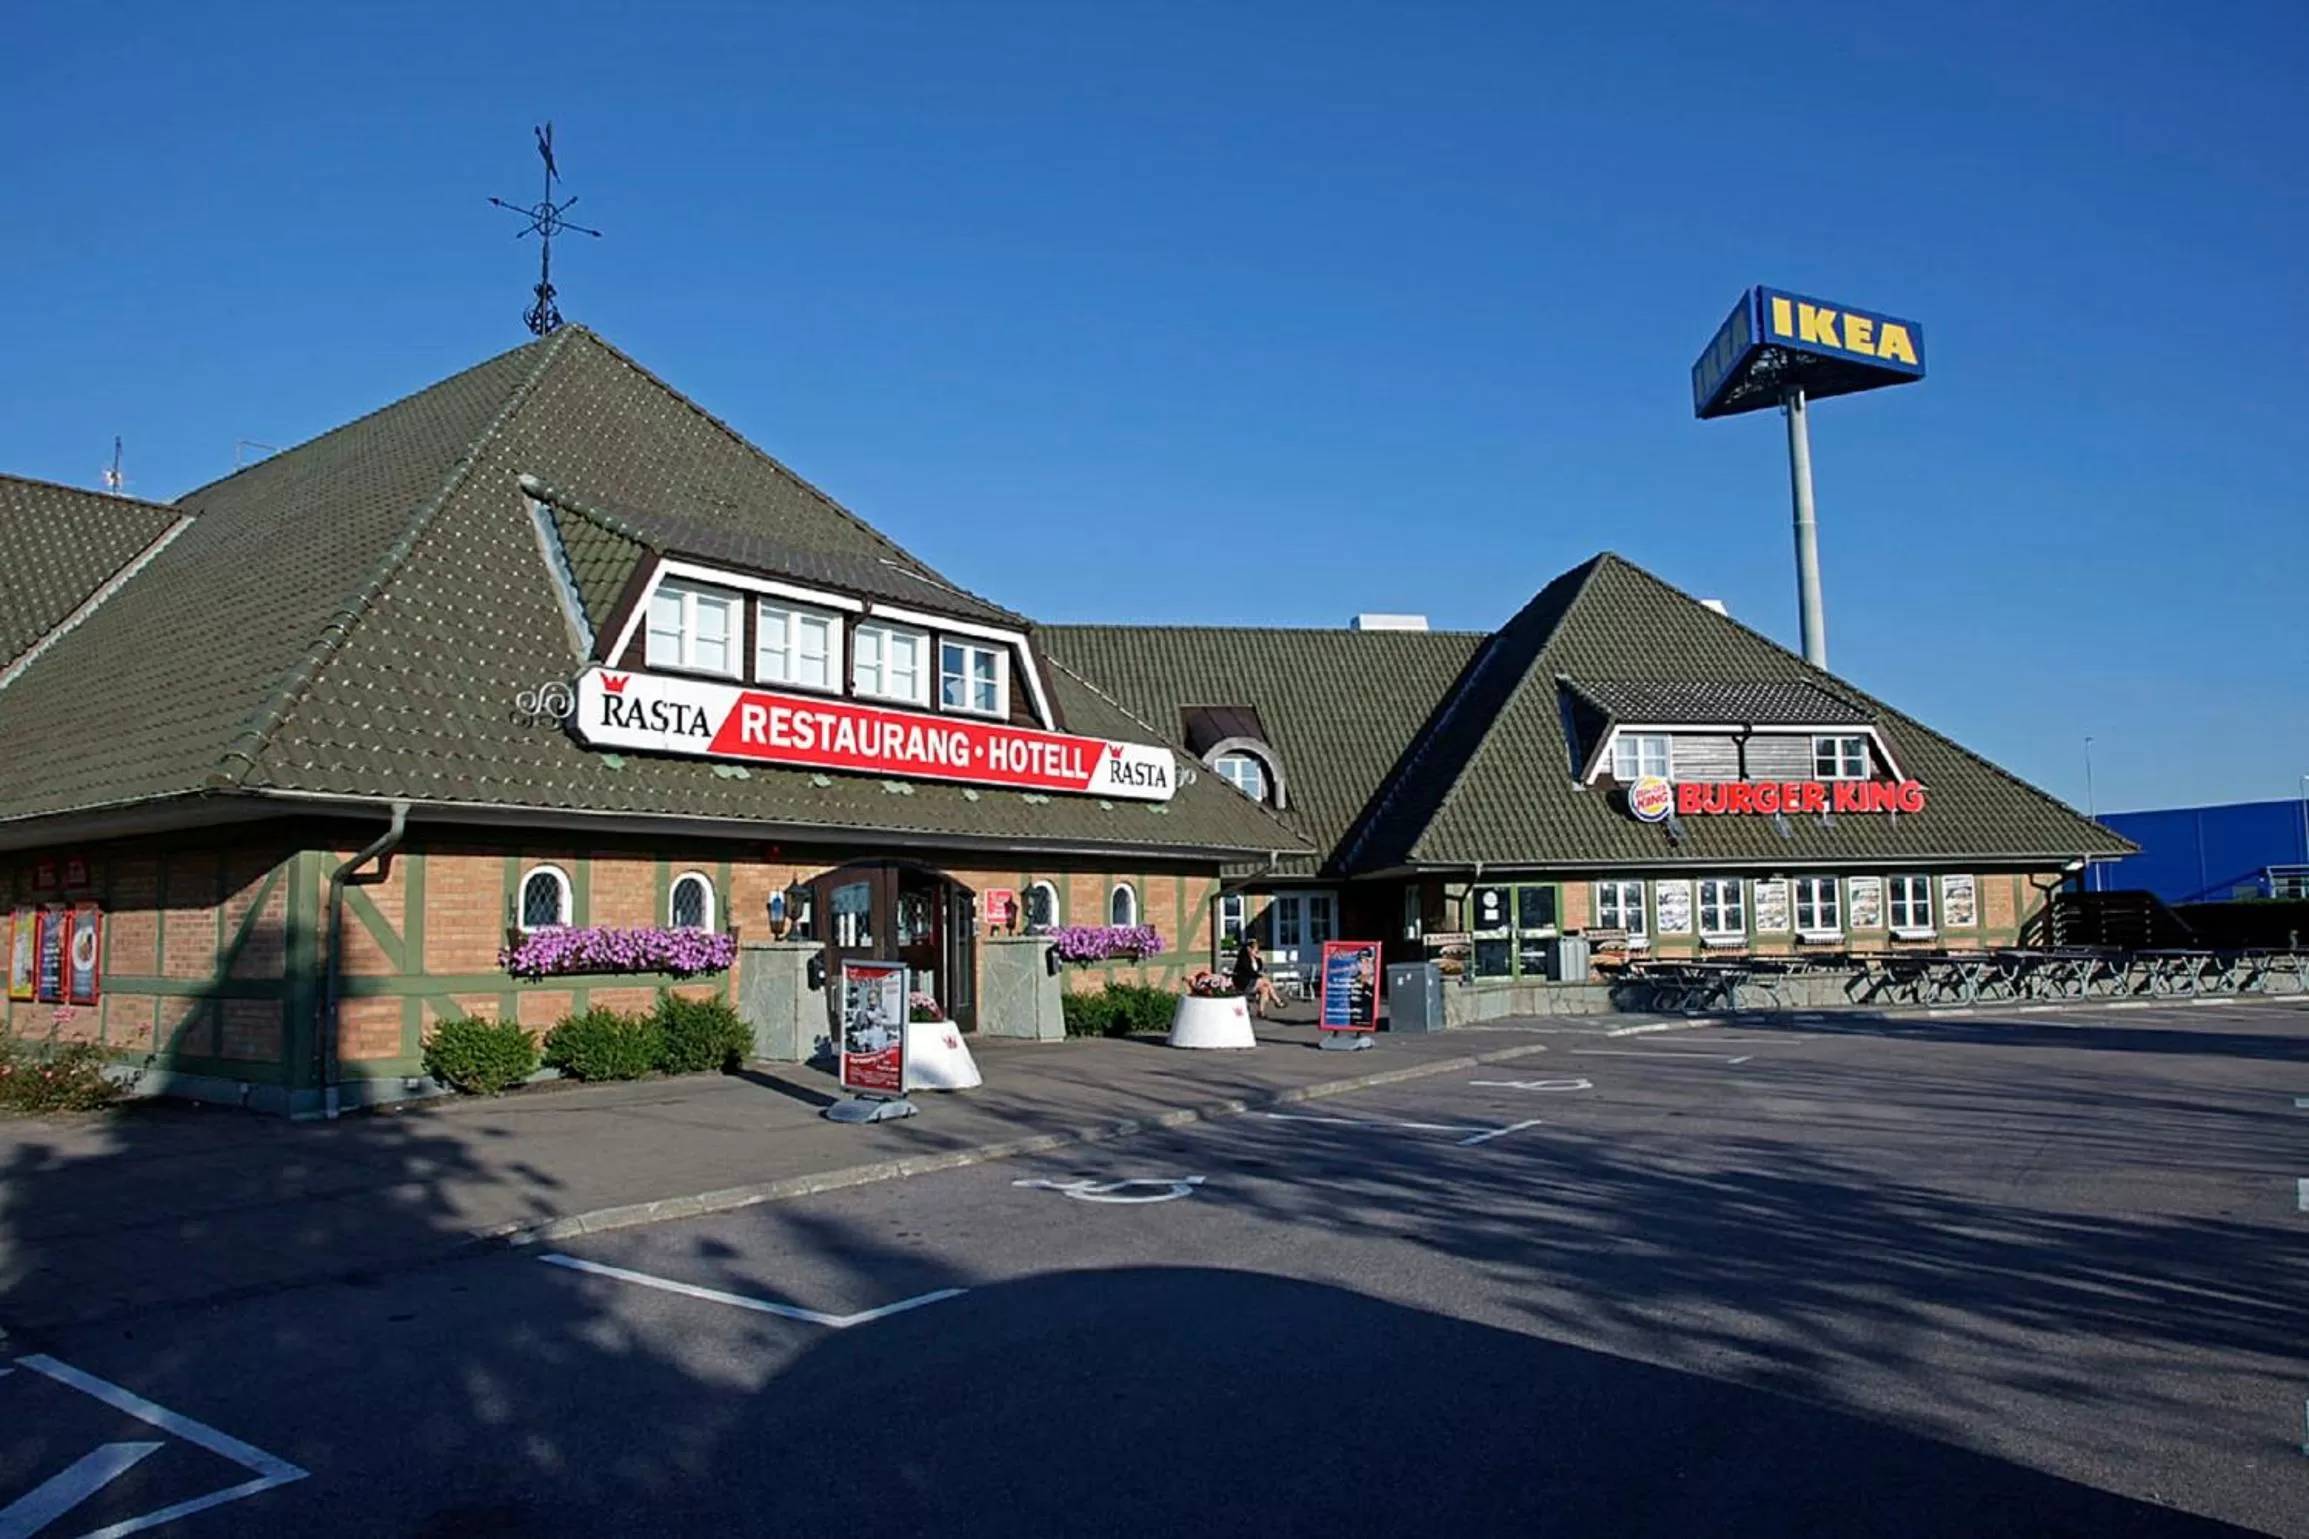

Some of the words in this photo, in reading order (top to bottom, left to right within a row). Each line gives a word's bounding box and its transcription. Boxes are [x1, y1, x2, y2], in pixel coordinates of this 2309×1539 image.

[1772, 297, 1918, 365] IKEA
[601, 694, 712, 738] RASTA
[741, 703, 969, 767] RESTAURANG
[989, 736, 1089, 779] HOTELL
[1110, 759, 1167, 788] RASTA
[1678, 780, 1825, 815] BURGER
[1832, 779, 1925, 814] KING
